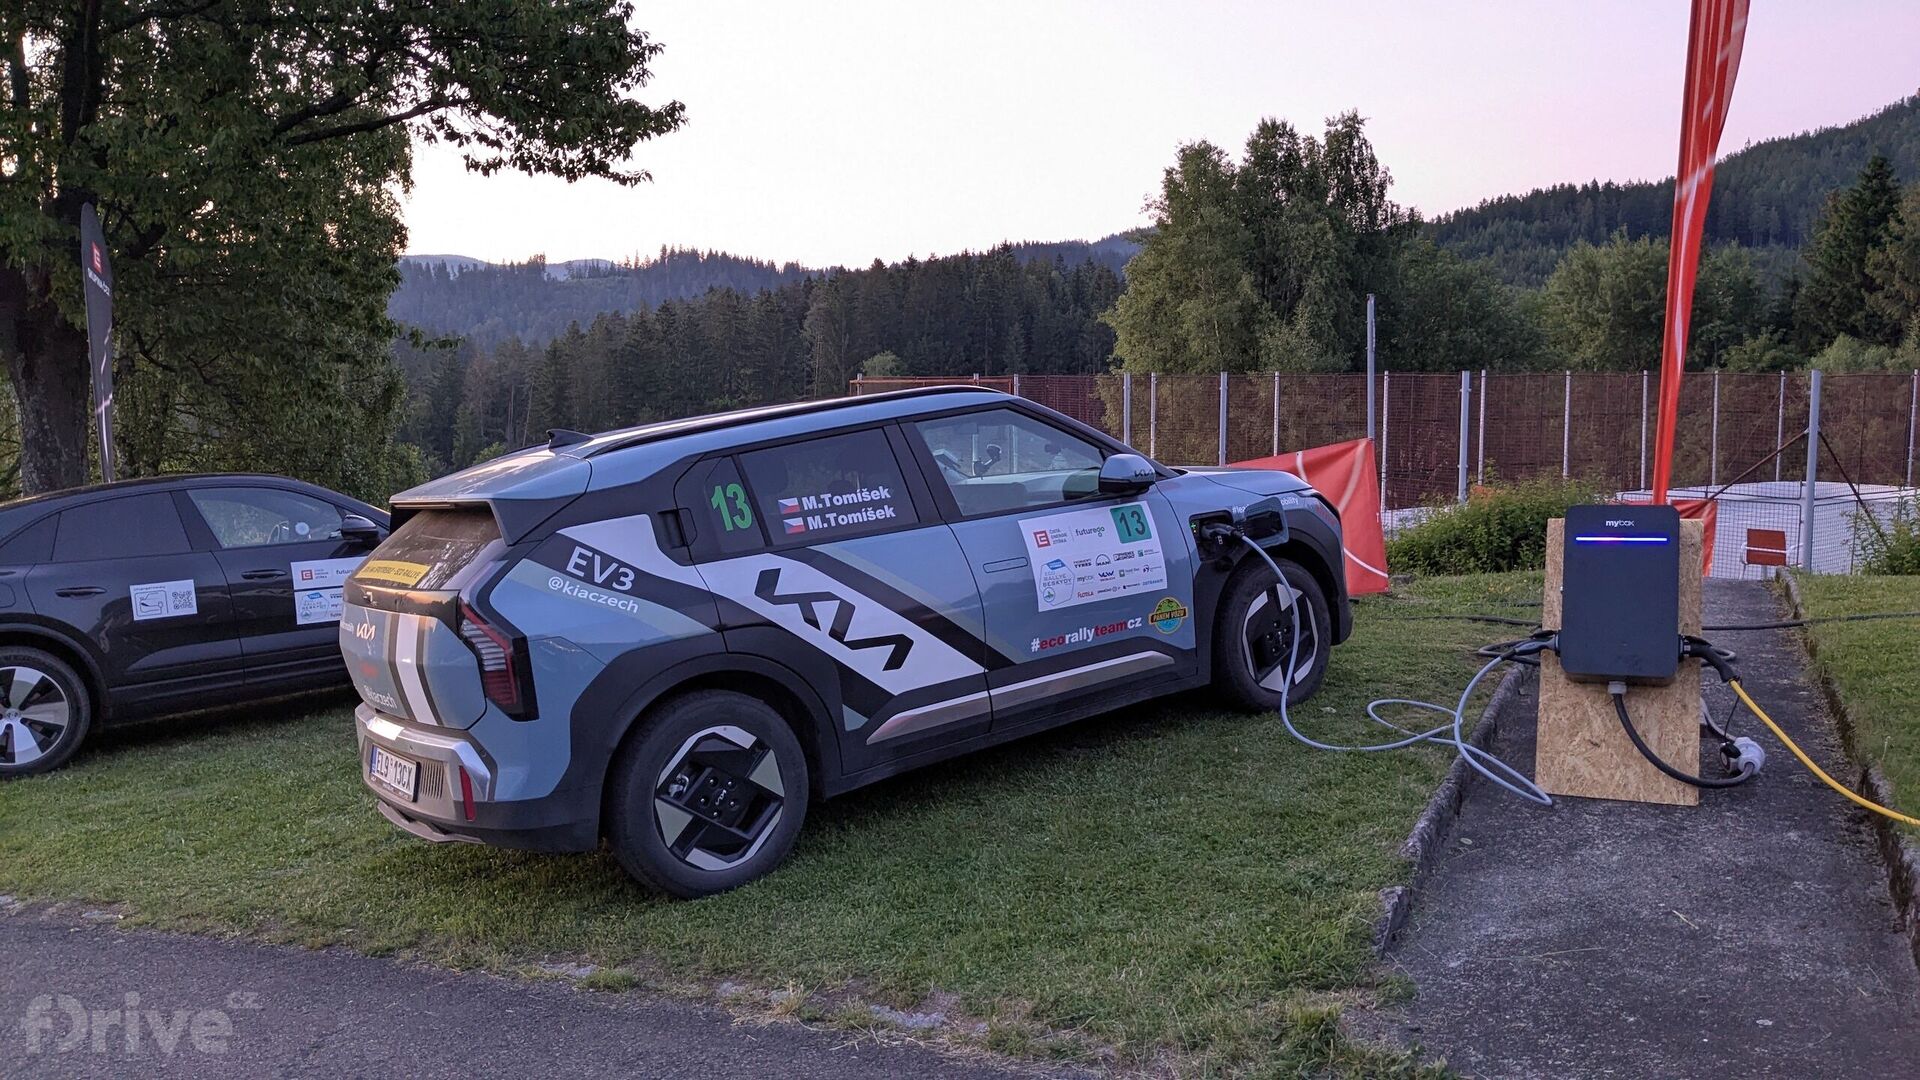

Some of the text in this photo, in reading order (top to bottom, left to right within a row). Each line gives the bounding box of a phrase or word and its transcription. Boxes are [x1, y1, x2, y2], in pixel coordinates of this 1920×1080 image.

[711, 483, 752, 531] 13
[802, 486, 891, 510] M.Tomíšek
[806, 504, 896, 530] M.Tomíšek
[1119, 510, 1146, 537] 13
[1605, 519, 1635, 528] mybox
[1075, 526, 1105, 537] futurego
[565, 545, 636, 591] EV3
[548, 576, 639, 614] @kiaczech
[1031, 616, 1142, 652] #ecorallyteamcz
